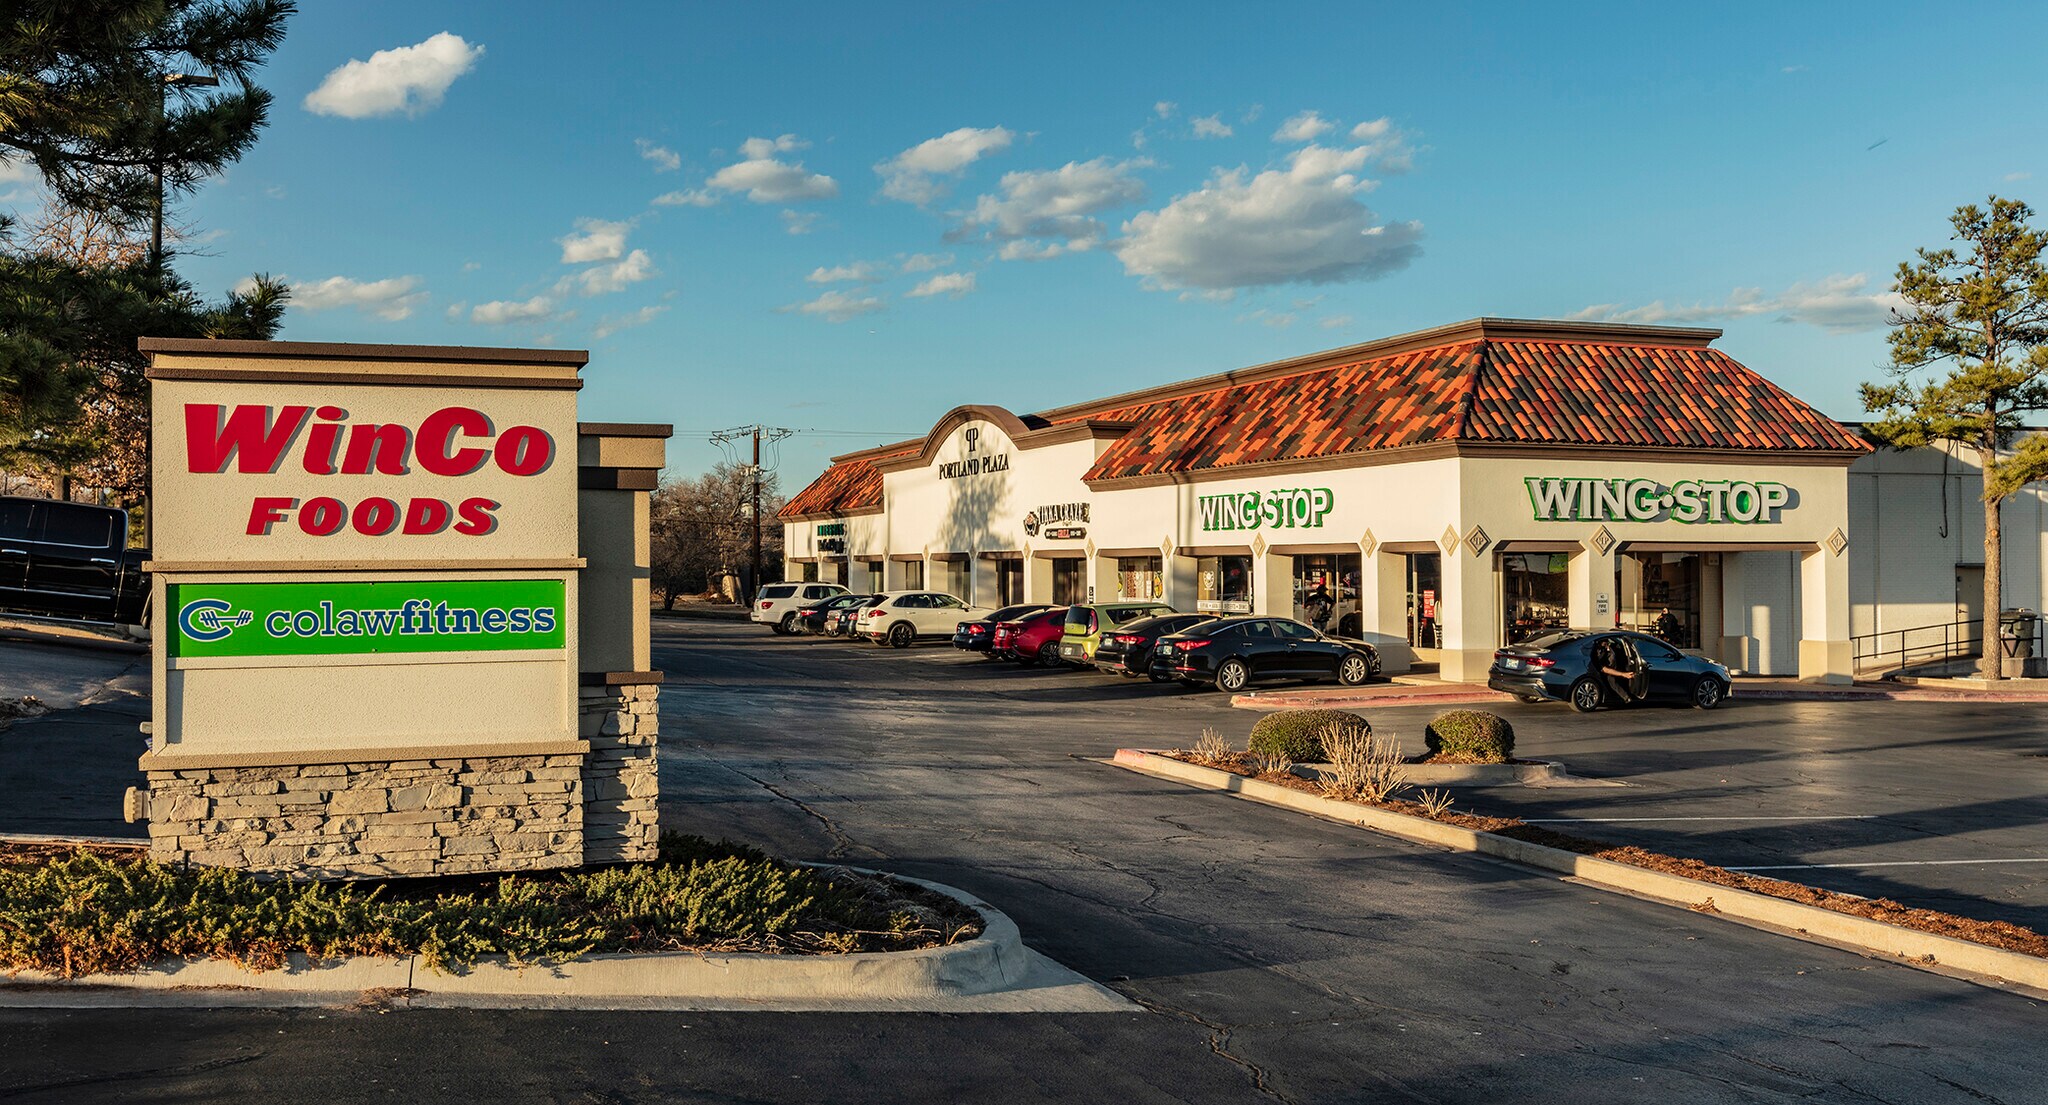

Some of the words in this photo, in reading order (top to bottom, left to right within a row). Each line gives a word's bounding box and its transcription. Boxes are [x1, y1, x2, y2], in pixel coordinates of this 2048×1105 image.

[184, 403, 555, 477] WinCo
[939, 459, 979, 480] PORTLAND
[982, 453, 1009, 474] PLAZA
[245, 496, 502, 537] FOODS
[265, 599, 556, 637] colawfitness
